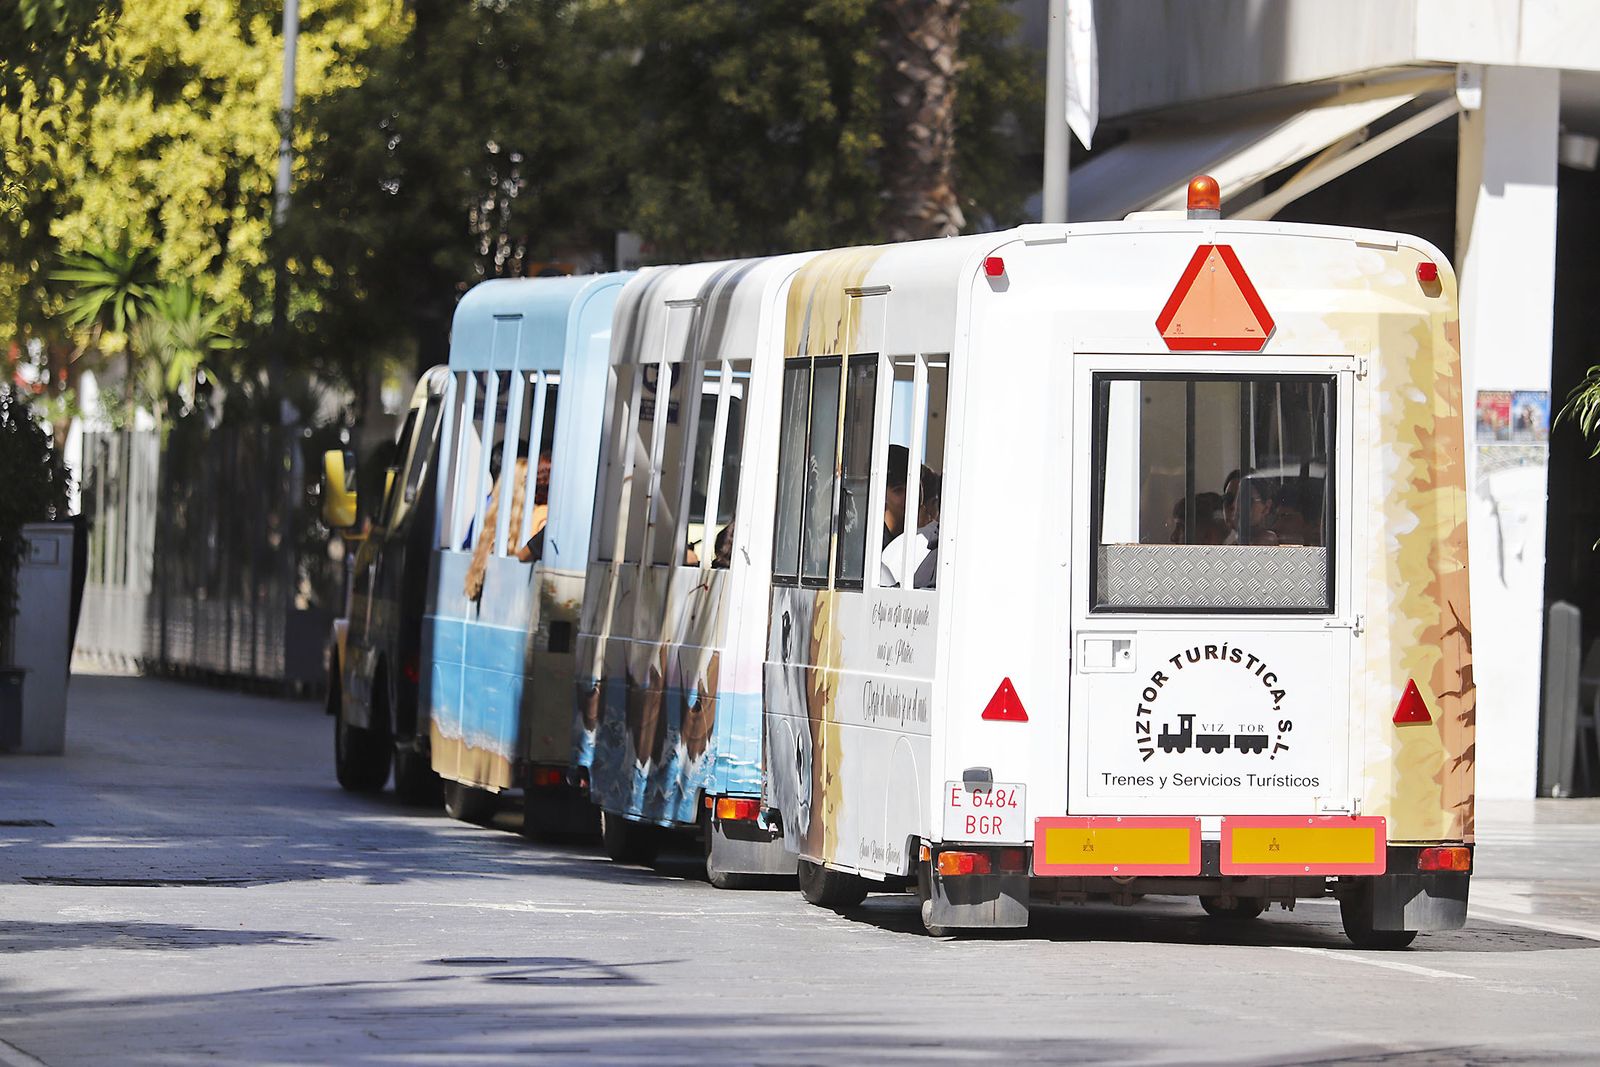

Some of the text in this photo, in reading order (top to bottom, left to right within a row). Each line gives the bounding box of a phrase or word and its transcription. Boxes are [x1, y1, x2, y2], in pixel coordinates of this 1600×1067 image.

[1136, 642, 1292, 762] VIZTOR TURÍSTICA, S.L.
[1202, 724, 1264, 732] VIZ TOR
[1102, 773, 1319, 789] Trenes y Servicios Turísticos
[952, 788, 1017, 808] E 6484
[966, 815, 1002, 835] BGR
